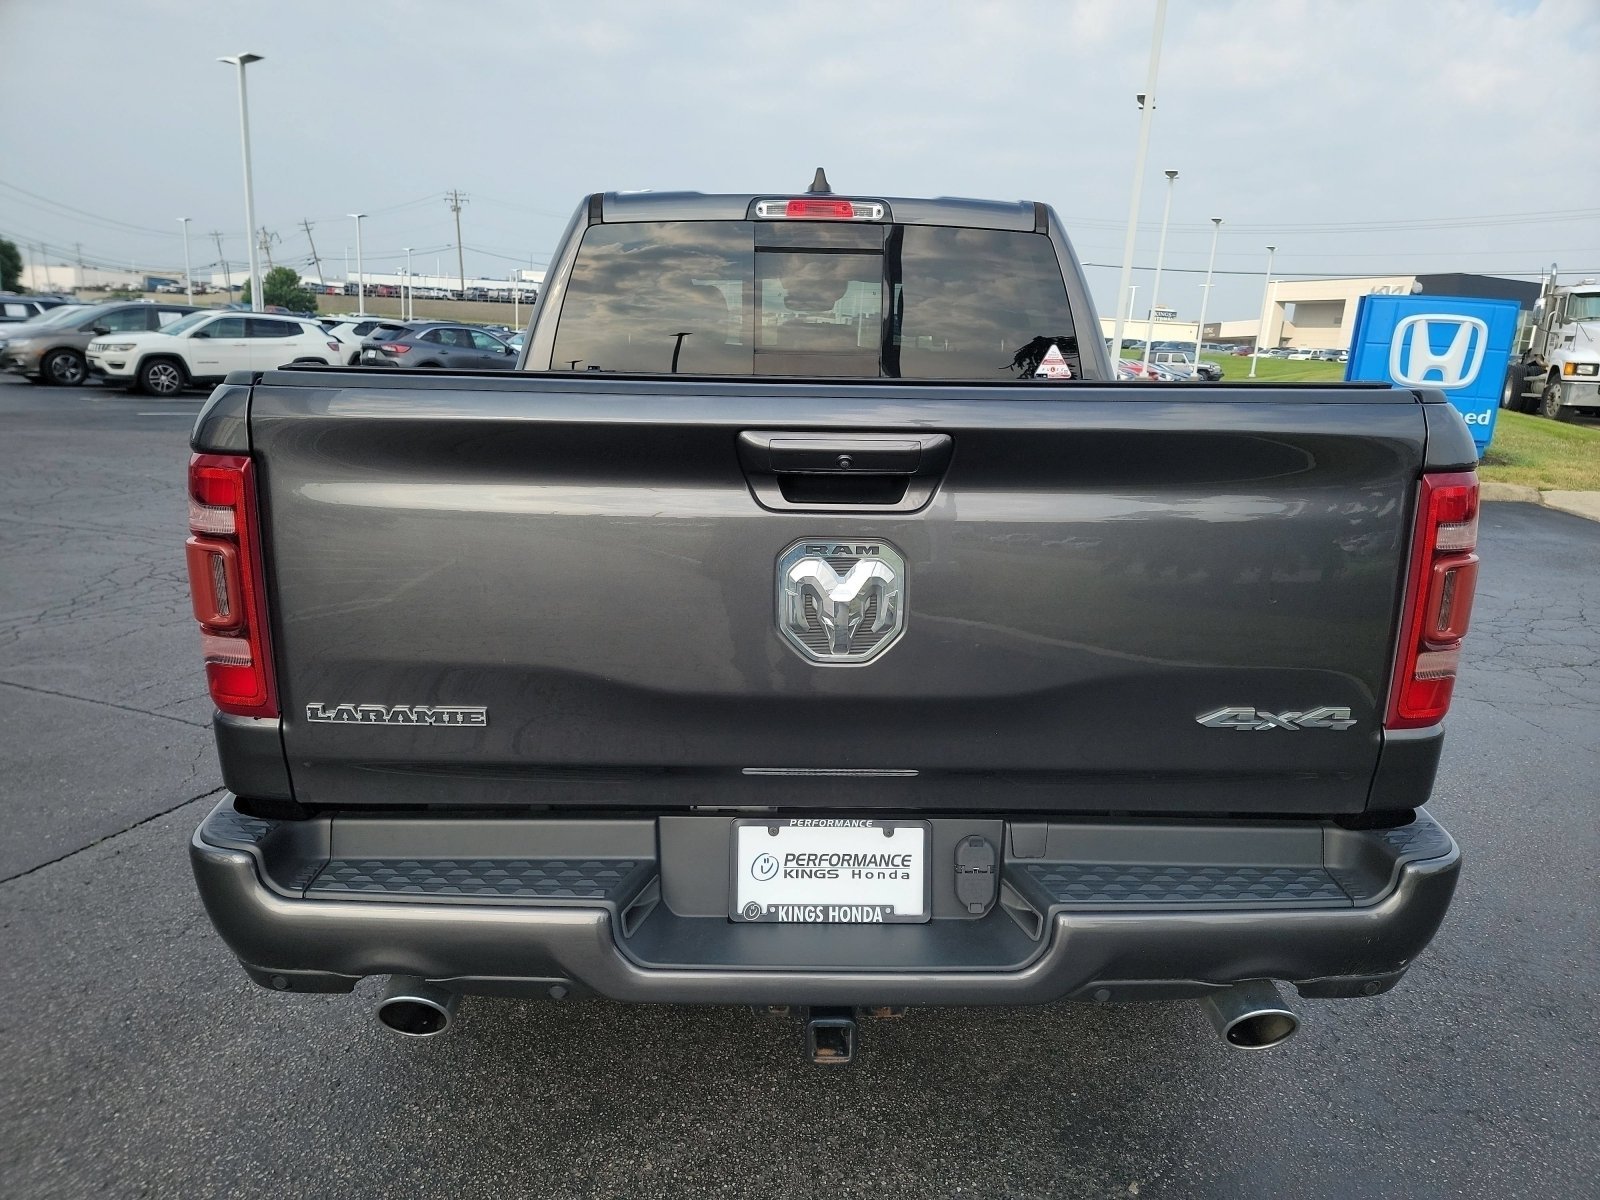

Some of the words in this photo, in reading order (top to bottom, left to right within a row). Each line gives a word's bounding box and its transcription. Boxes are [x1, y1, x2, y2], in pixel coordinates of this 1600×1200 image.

[1459, 409, 1491, 425] ed
[805, 545, 880, 555] RAM
[306, 702, 488, 727] LARAMIE
[789, 819, 873, 828] PERFORMANCE
[784, 853, 912, 867] PERFORMANCE
[783, 869, 839, 879] KINGS
[852, 870, 910, 880] Honda
[778, 906, 824, 922] KINGS
[828, 907, 883, 923] HONDA
